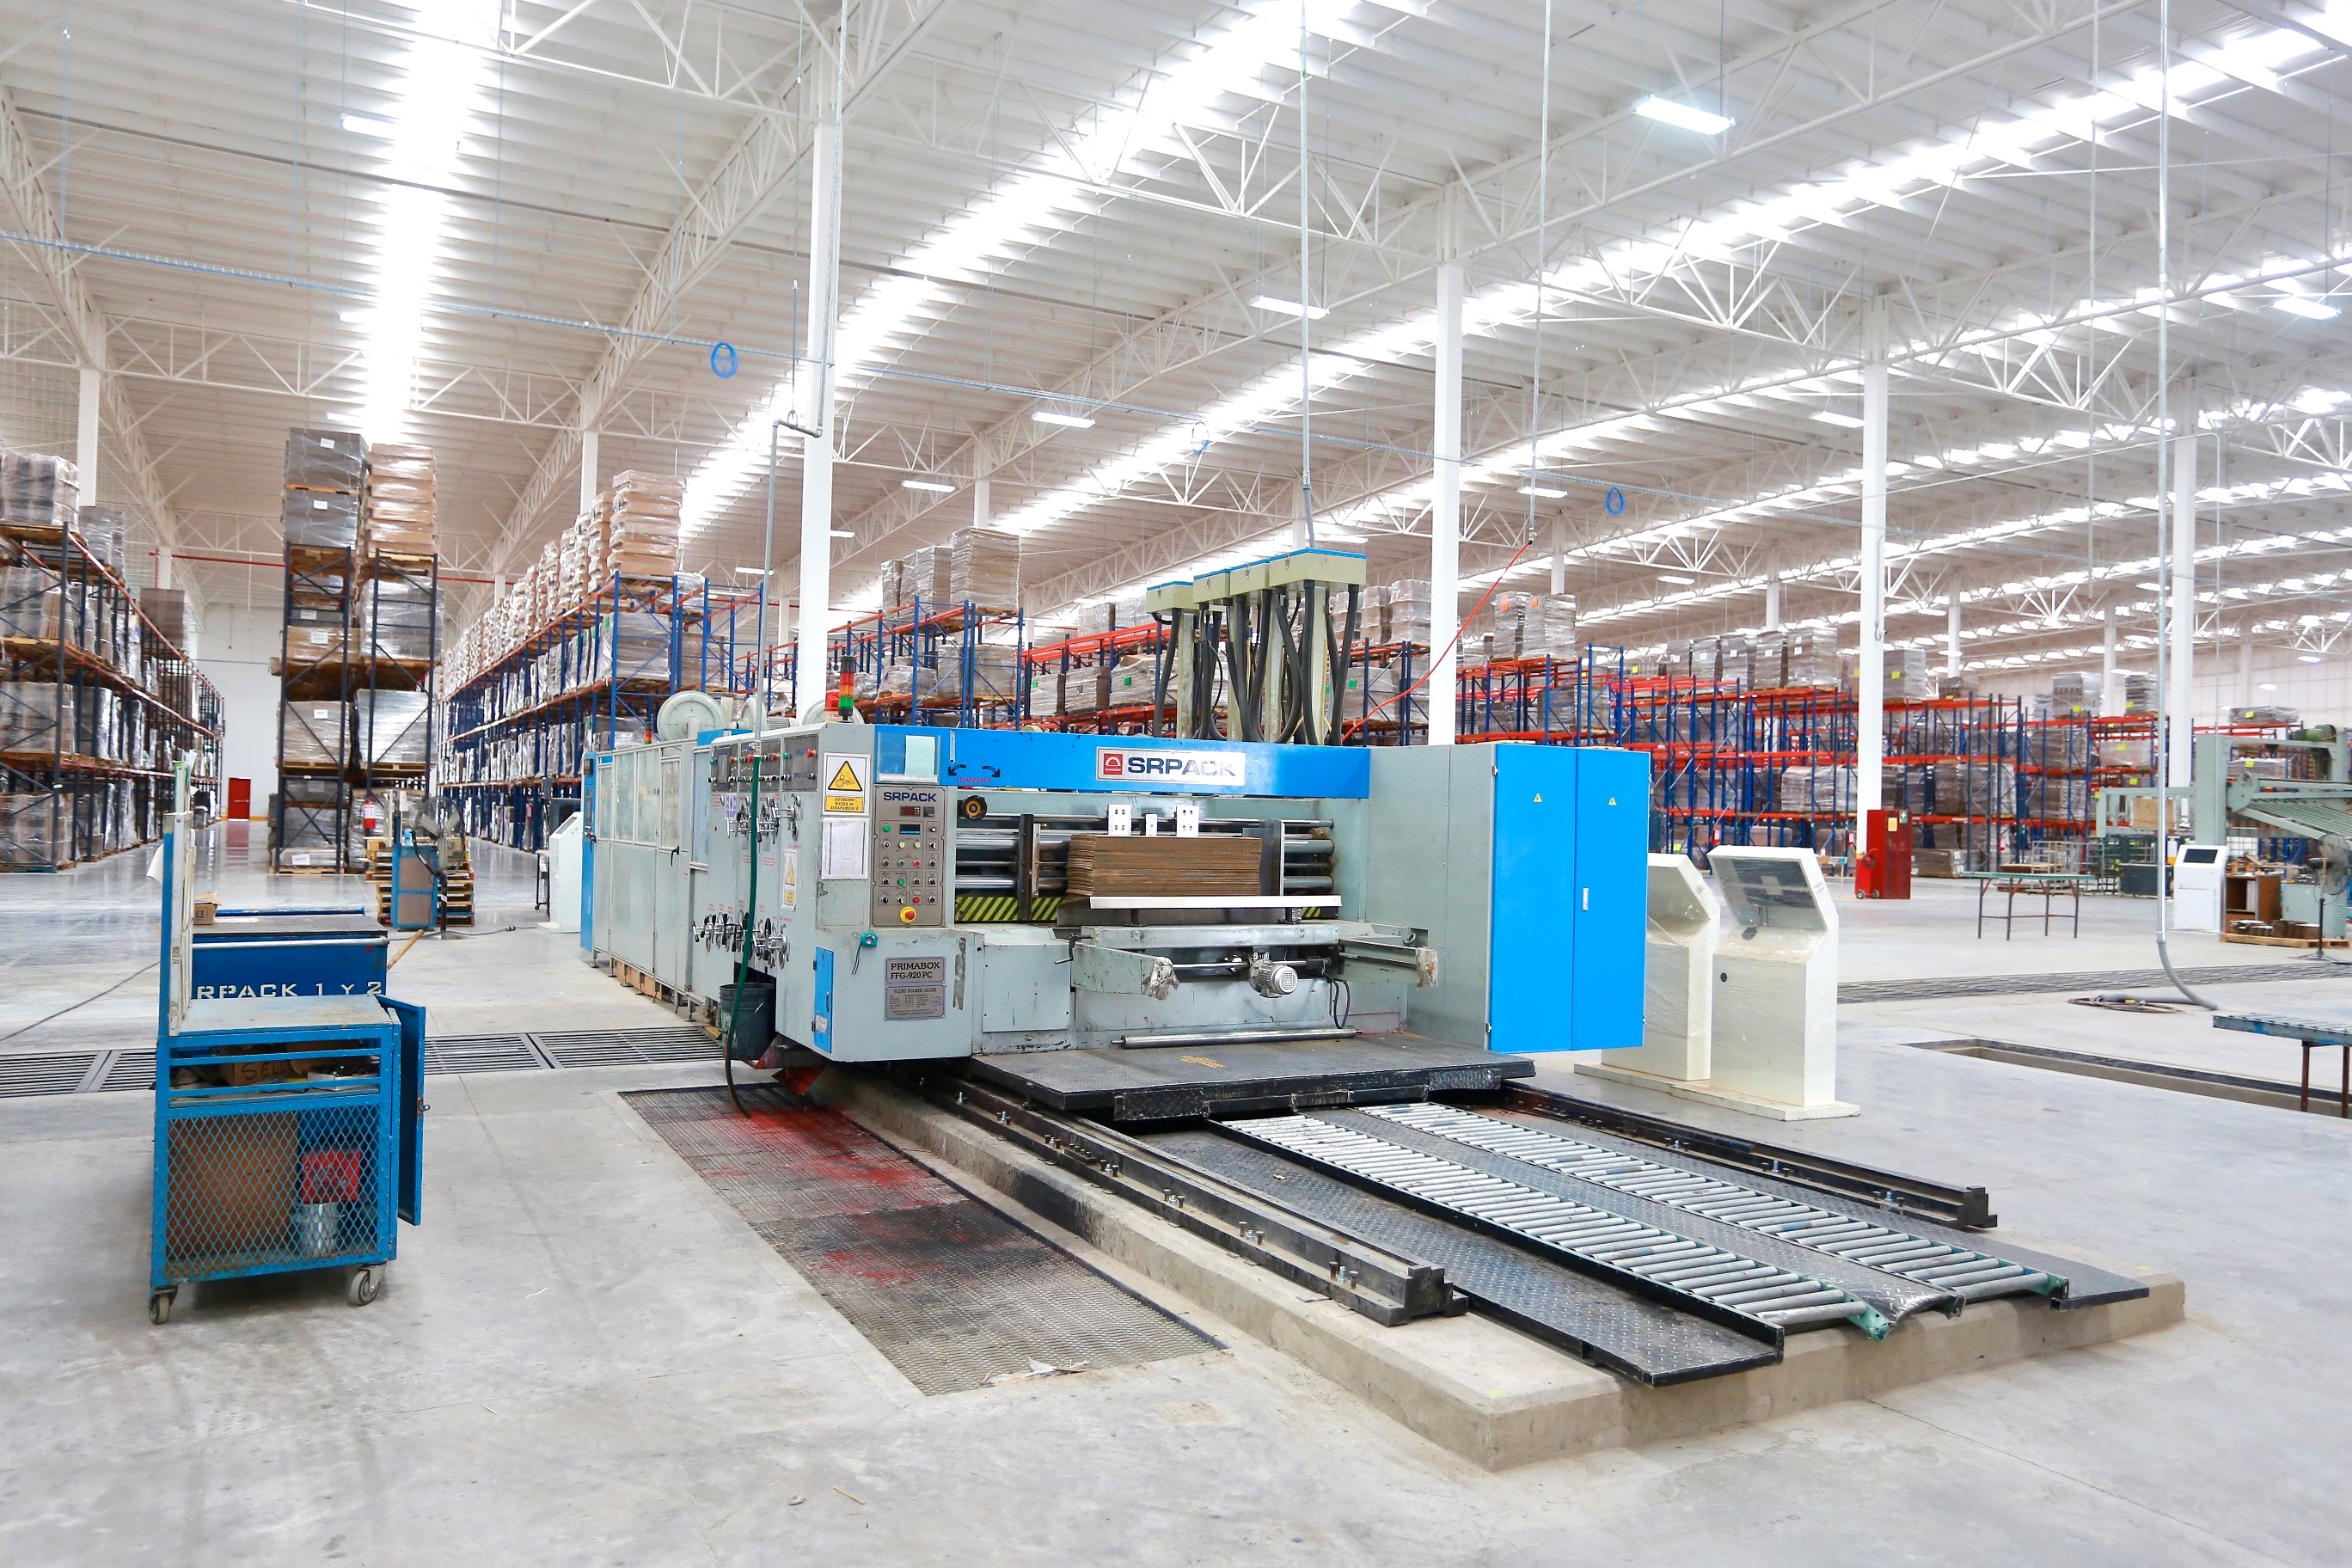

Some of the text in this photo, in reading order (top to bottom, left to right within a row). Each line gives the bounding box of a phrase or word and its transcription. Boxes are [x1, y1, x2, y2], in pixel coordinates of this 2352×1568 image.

[1128, 757, 1235, 776] SRPACK
[884, 792, 937, 802] SRPACK
[315, 983, 323, 996] 1
[340, 984, 354, 995] Y
[367, 981, 382, 995] 2
